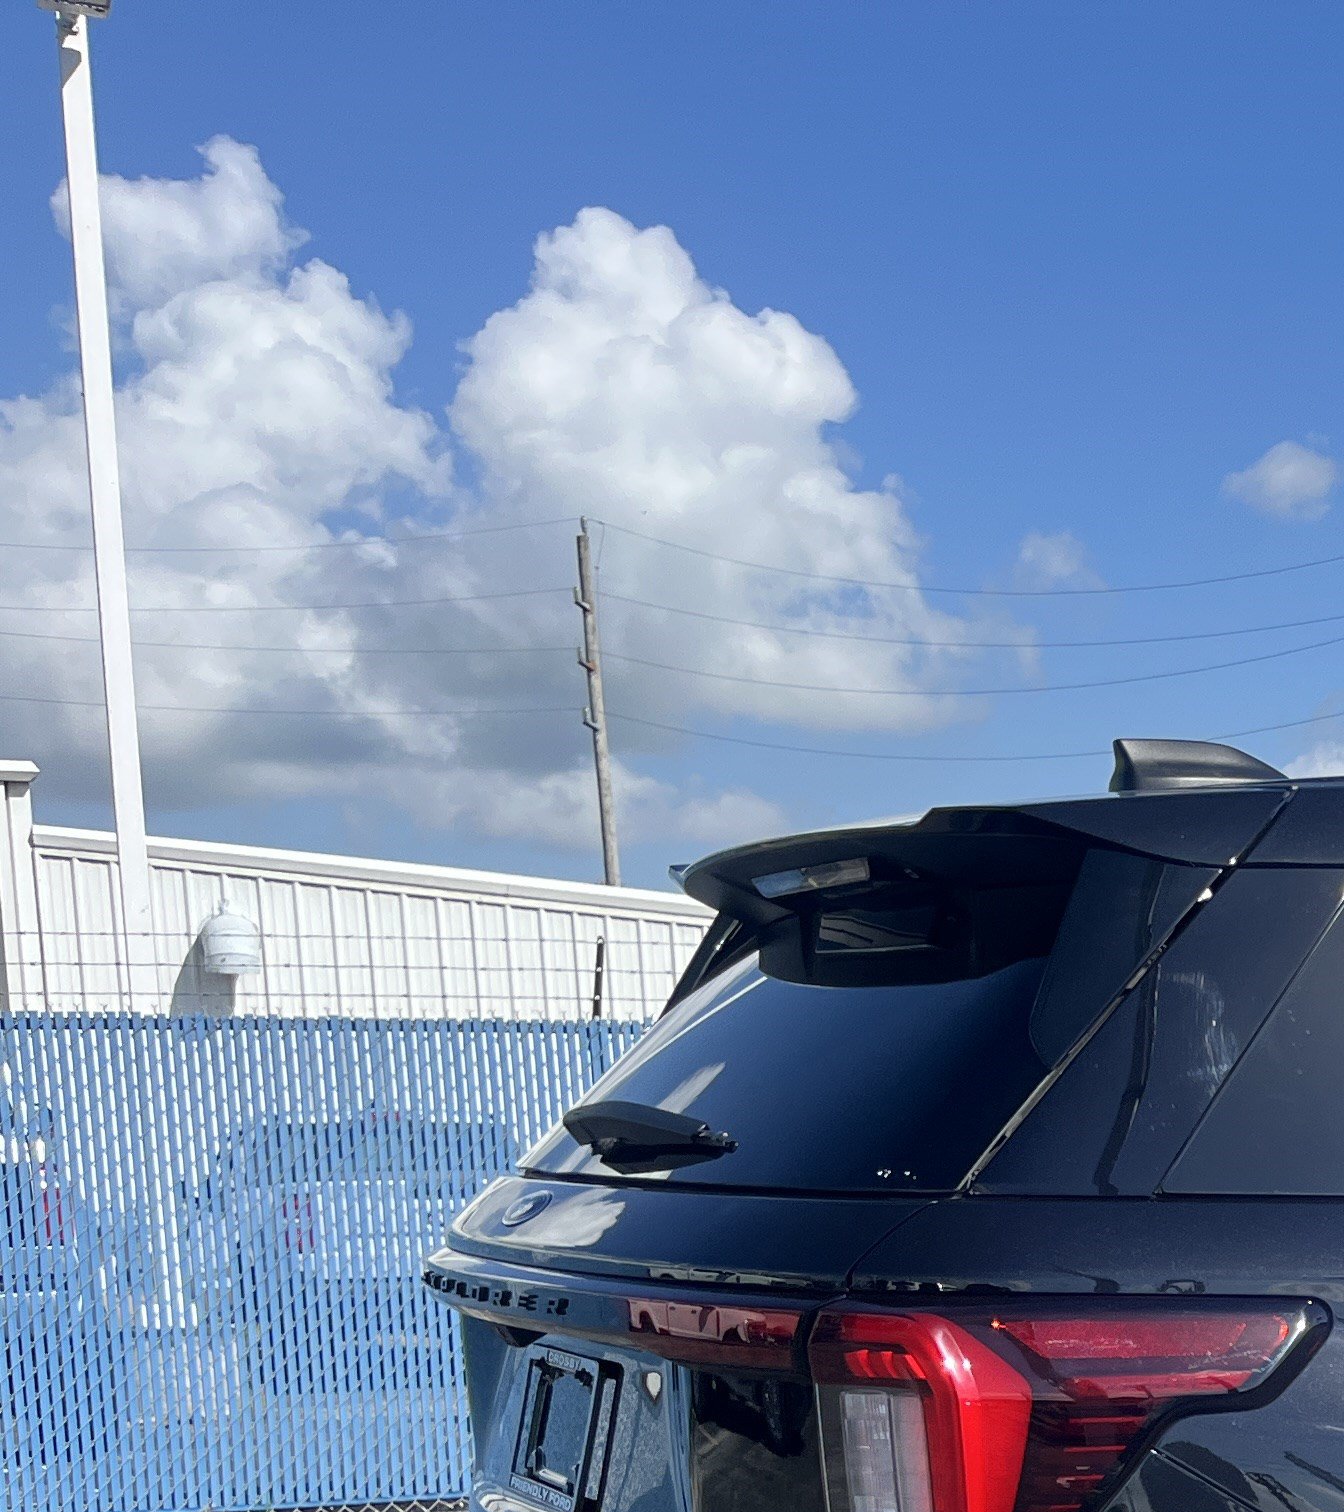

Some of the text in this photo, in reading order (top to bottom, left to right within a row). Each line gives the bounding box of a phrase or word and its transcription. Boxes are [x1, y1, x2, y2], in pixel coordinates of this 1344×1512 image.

[549, 1351, 580, 1371] CROSBY
[511, 1476, 572, 1512] FRIENDLY FORD
